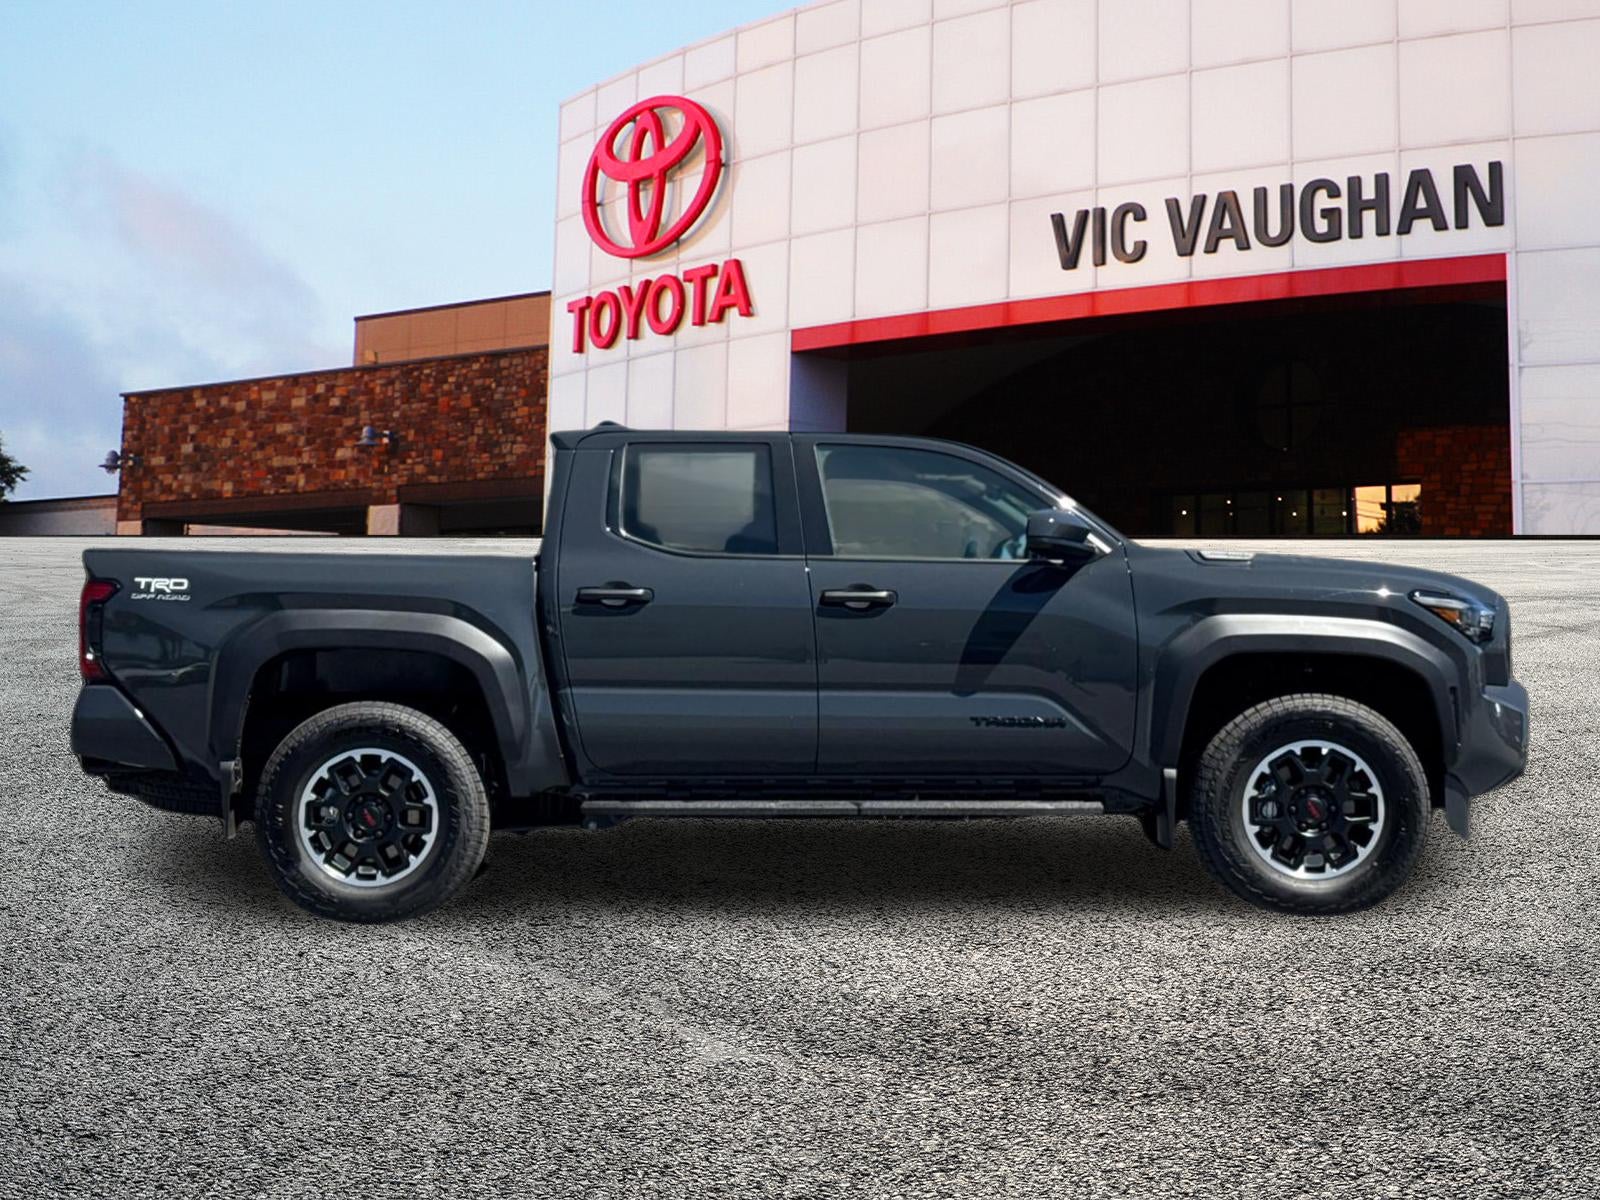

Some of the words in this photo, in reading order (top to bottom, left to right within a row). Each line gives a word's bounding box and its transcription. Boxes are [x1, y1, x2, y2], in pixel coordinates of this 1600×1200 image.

[1050, 200, 1148, 270] VIC
[1165, 160, 1505, 257] VAUGHAN
[567, 258, 754, 354] TOYOTA
[130, 592, 156, 600] OFF
[134, 577, 189, 593] TRD
